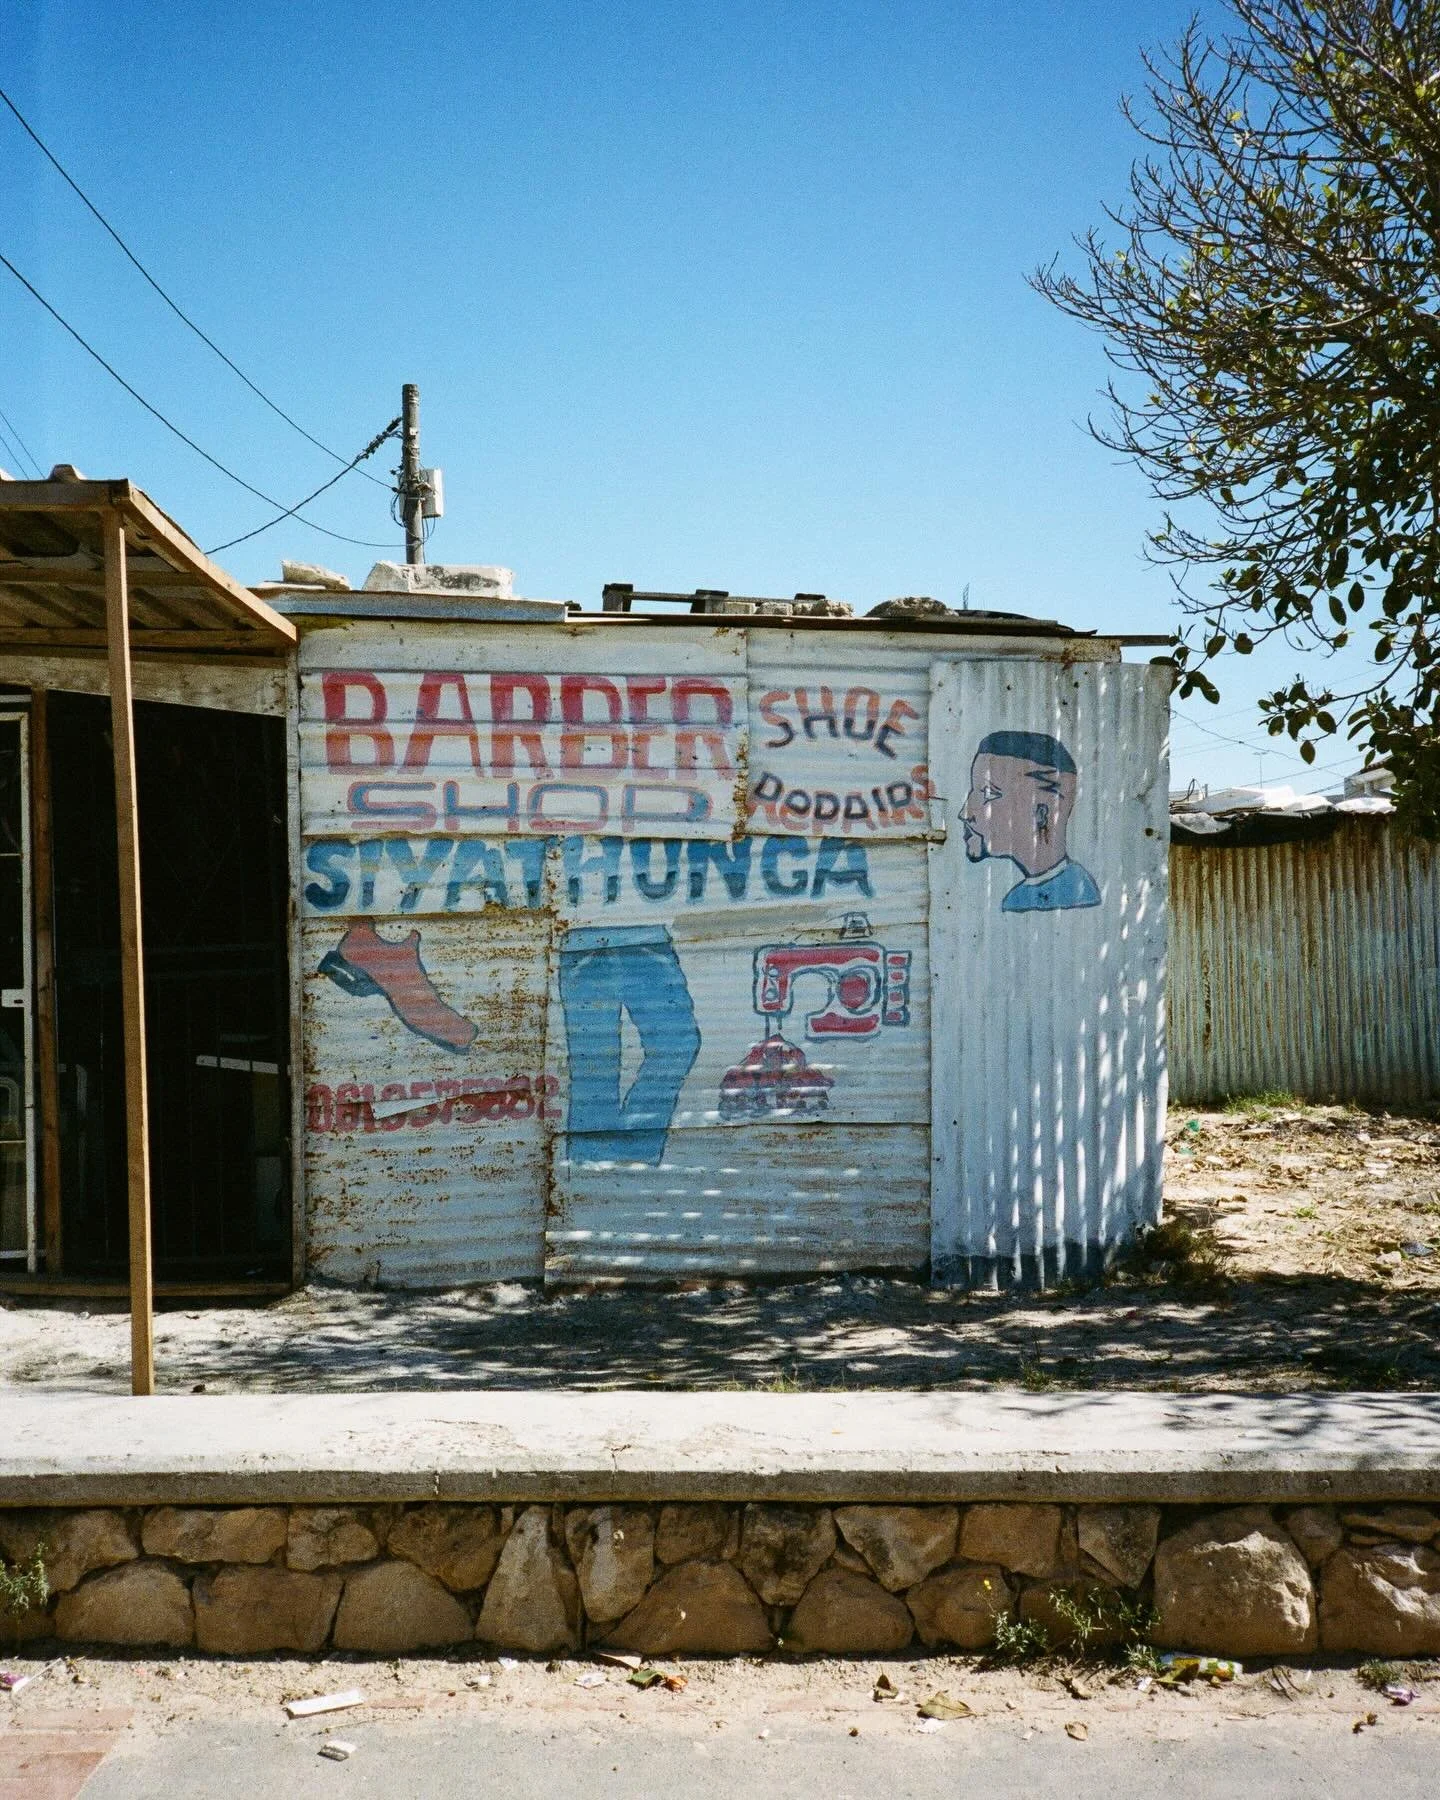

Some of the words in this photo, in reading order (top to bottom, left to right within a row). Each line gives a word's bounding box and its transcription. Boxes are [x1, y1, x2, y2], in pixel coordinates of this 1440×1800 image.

[322, 672, 734, 781] BARBER
[758, 684, 921, 761] SHOE
[347, 779, 714, 833] SHOP
[303, 836, 877, 911] SIYATHUNGA
